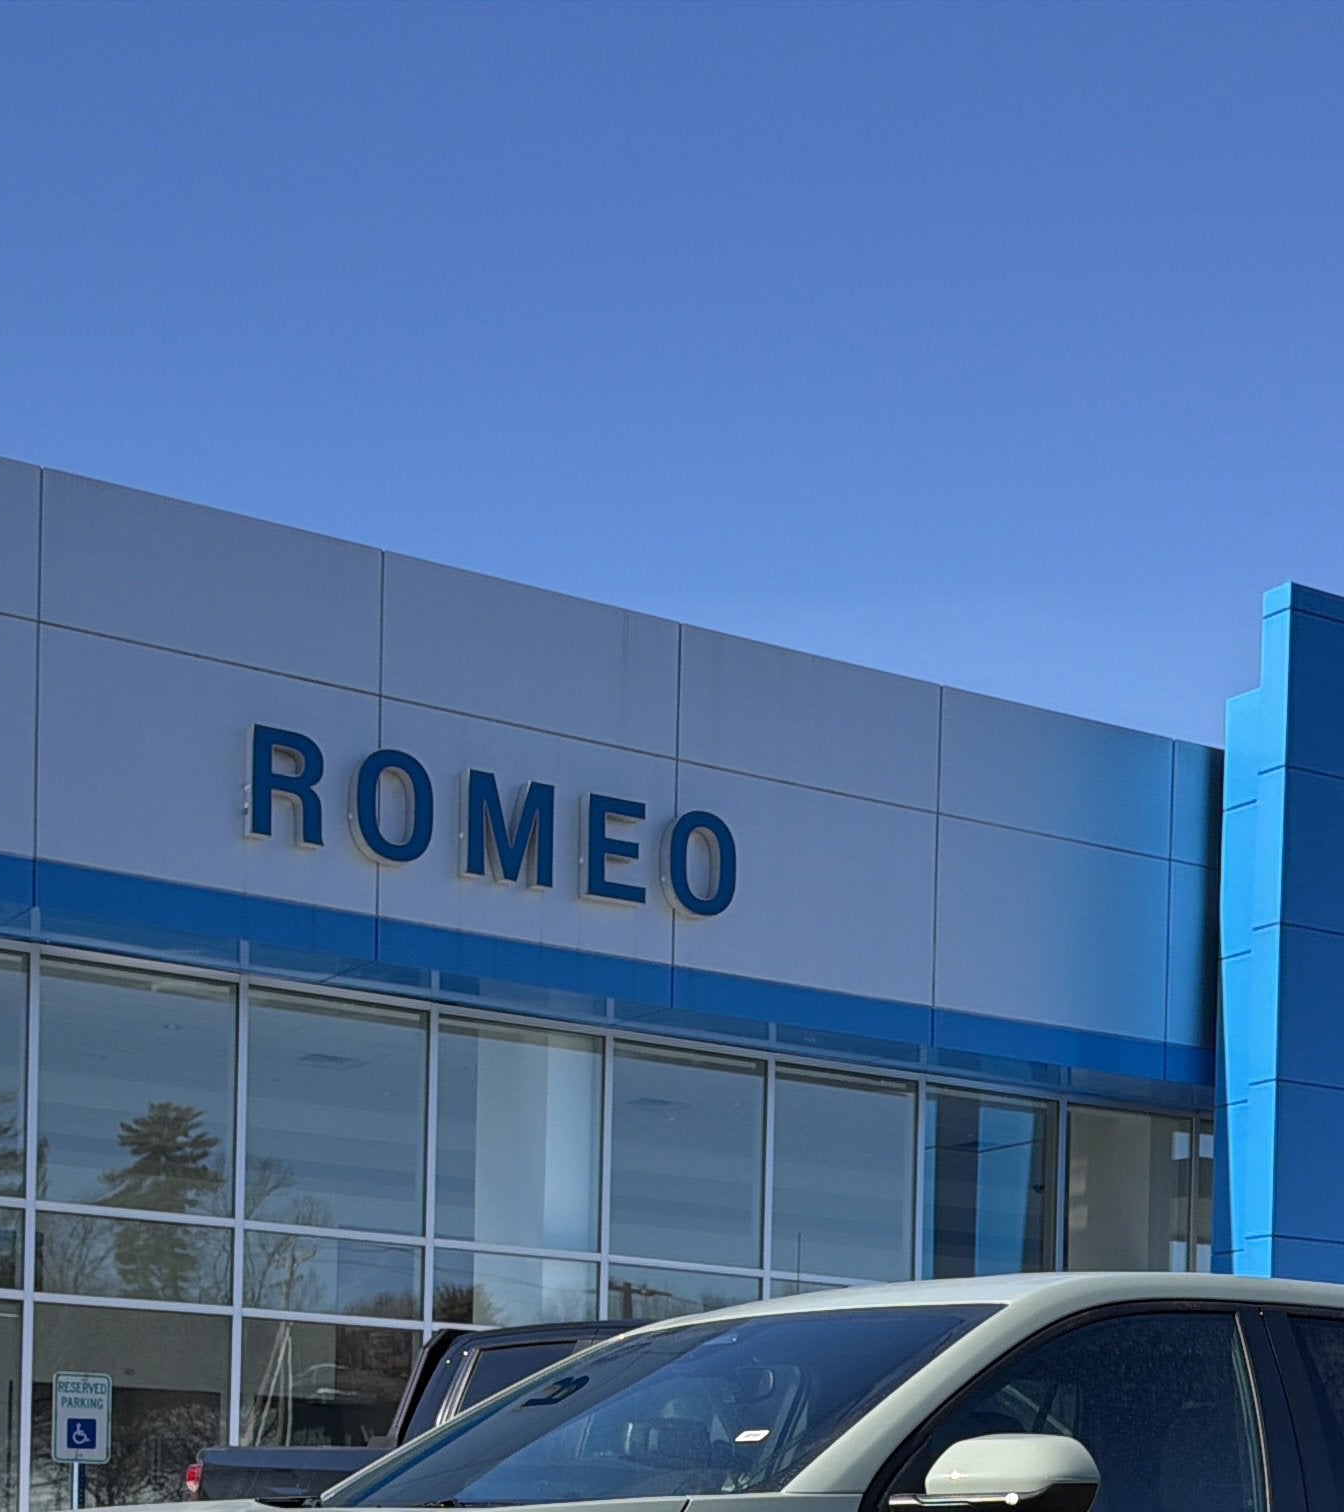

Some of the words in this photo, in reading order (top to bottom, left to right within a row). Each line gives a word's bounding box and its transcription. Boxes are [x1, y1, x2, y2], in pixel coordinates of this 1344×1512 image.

[244, 723, 737, 917] ROMEO
[58, 1381, 108, 1395] RESERVED
[61, 1396, 104, 1410] PARKING
